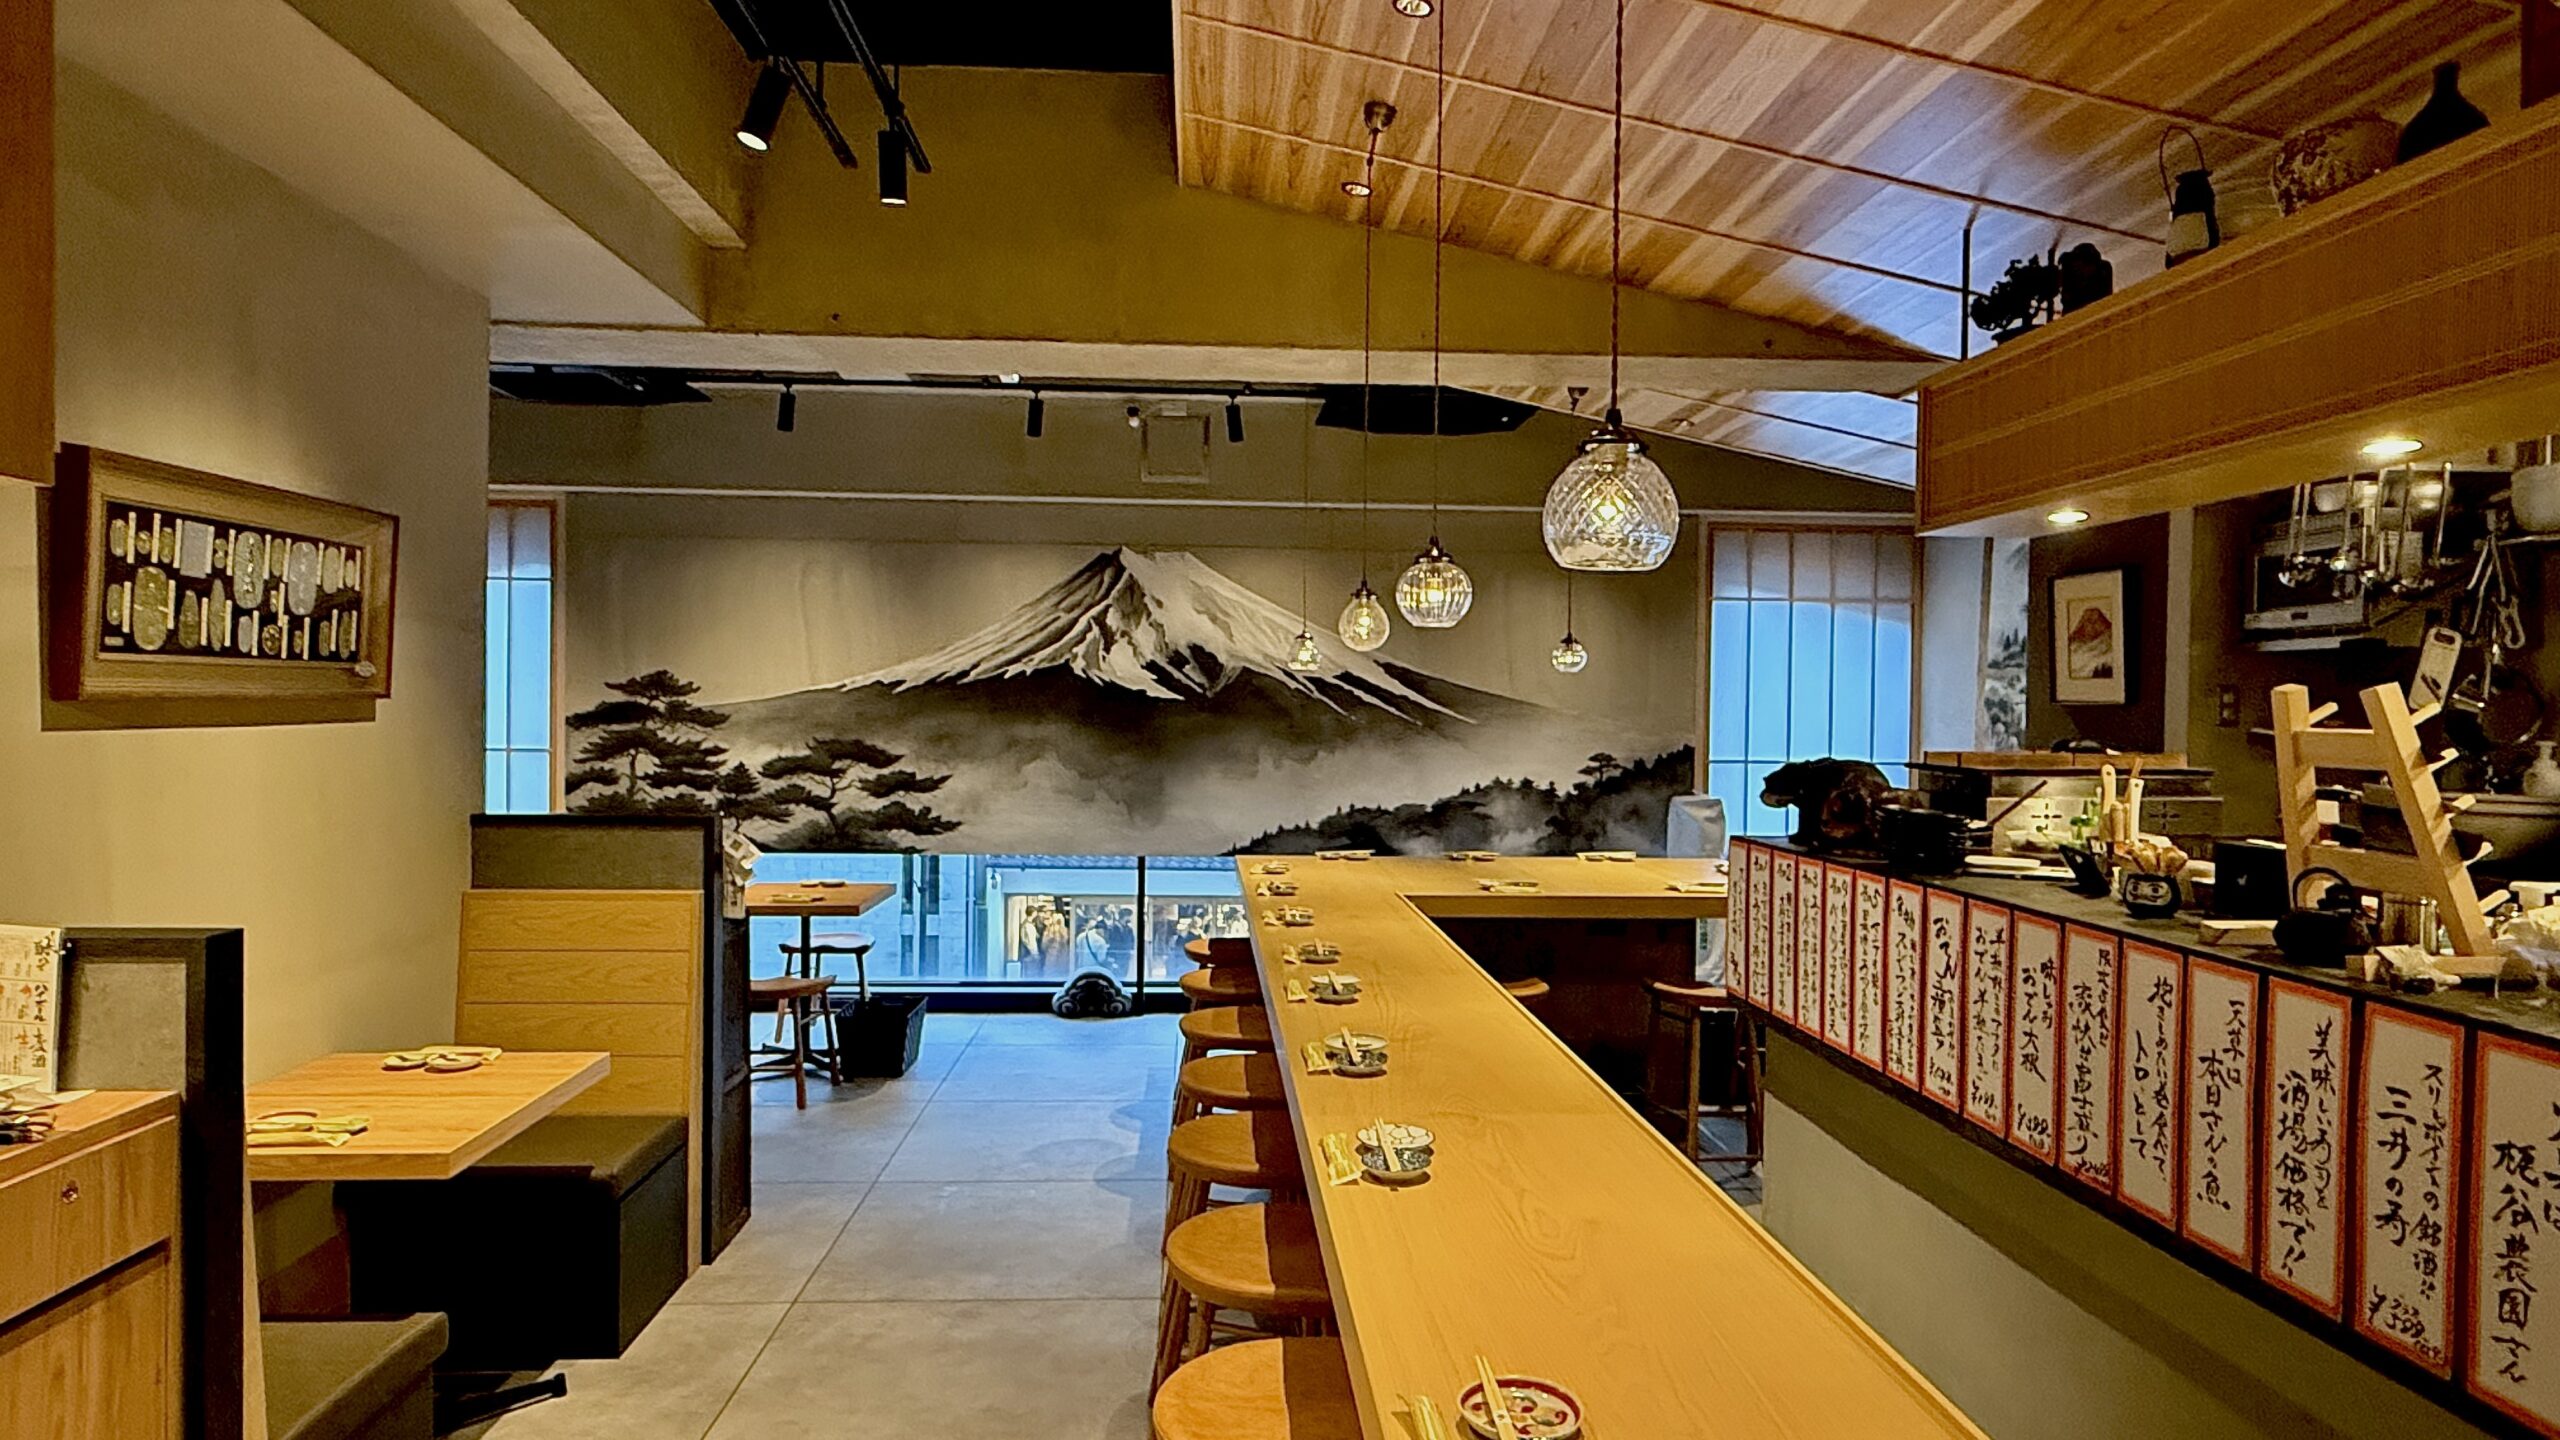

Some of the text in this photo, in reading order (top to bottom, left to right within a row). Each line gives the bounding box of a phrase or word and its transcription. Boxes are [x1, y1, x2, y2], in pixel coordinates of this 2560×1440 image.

[2019, 967, 2046, 1083] おでん大根
[2375, 1085, 2417, 1248] 三井の寿
